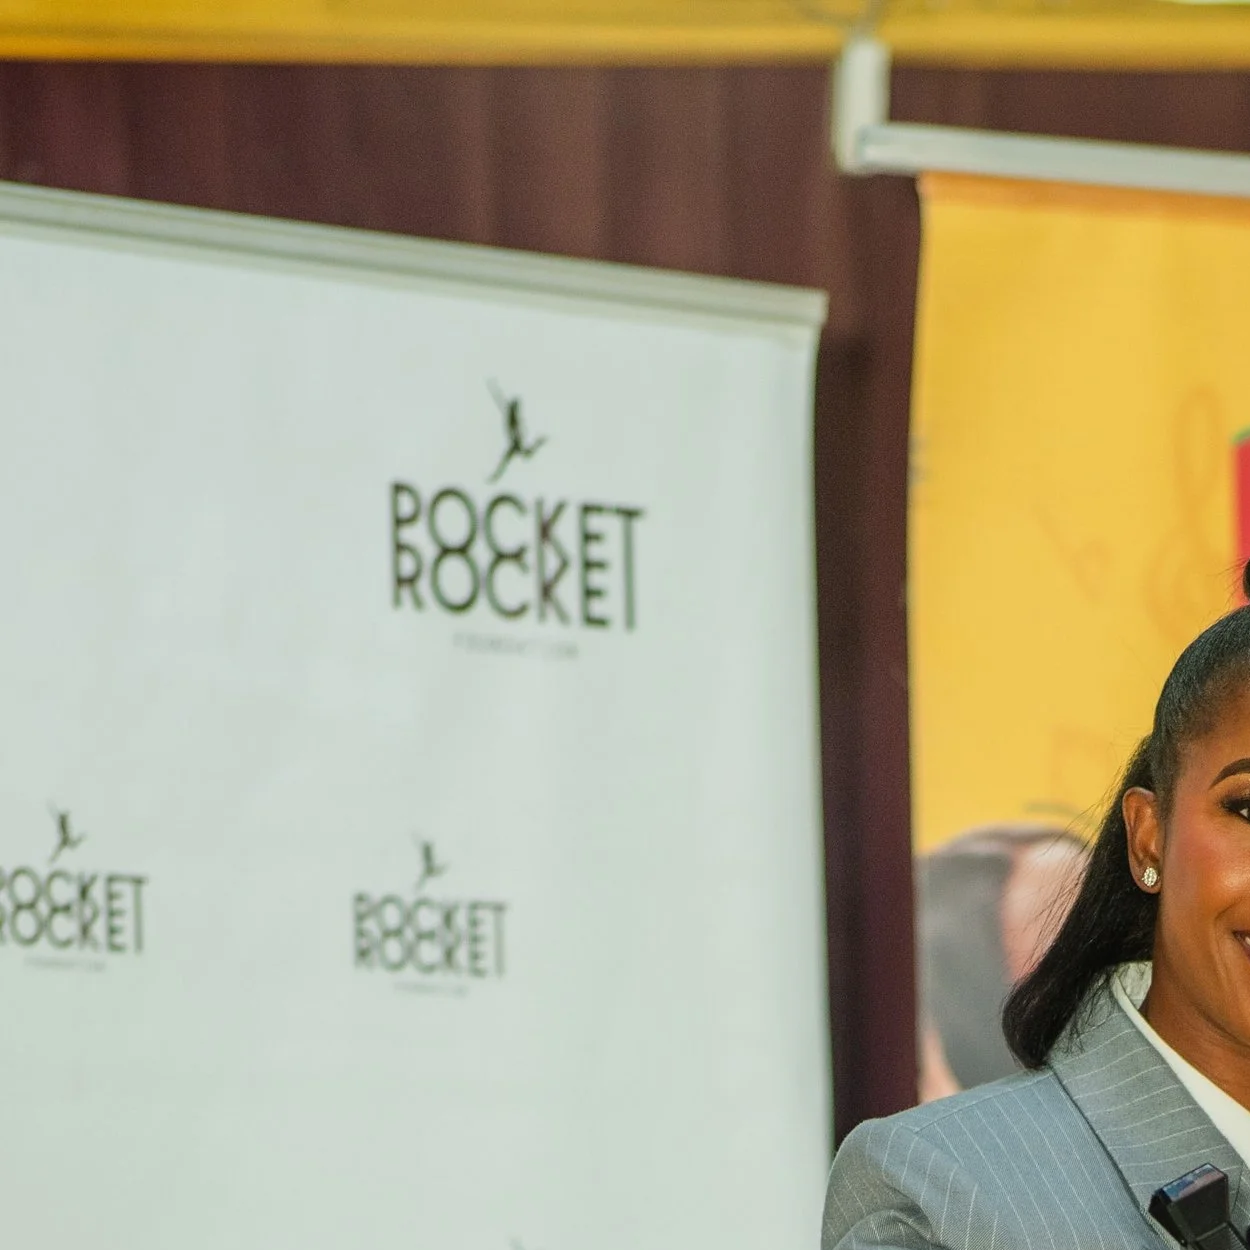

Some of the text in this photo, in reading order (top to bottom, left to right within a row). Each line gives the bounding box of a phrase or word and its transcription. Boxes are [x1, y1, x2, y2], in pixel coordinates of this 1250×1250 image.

[391, 482, 646, 563] POCKET
[391, 543, 638, 631] ROCKET
[354, 891, 511, 942] POCKET
